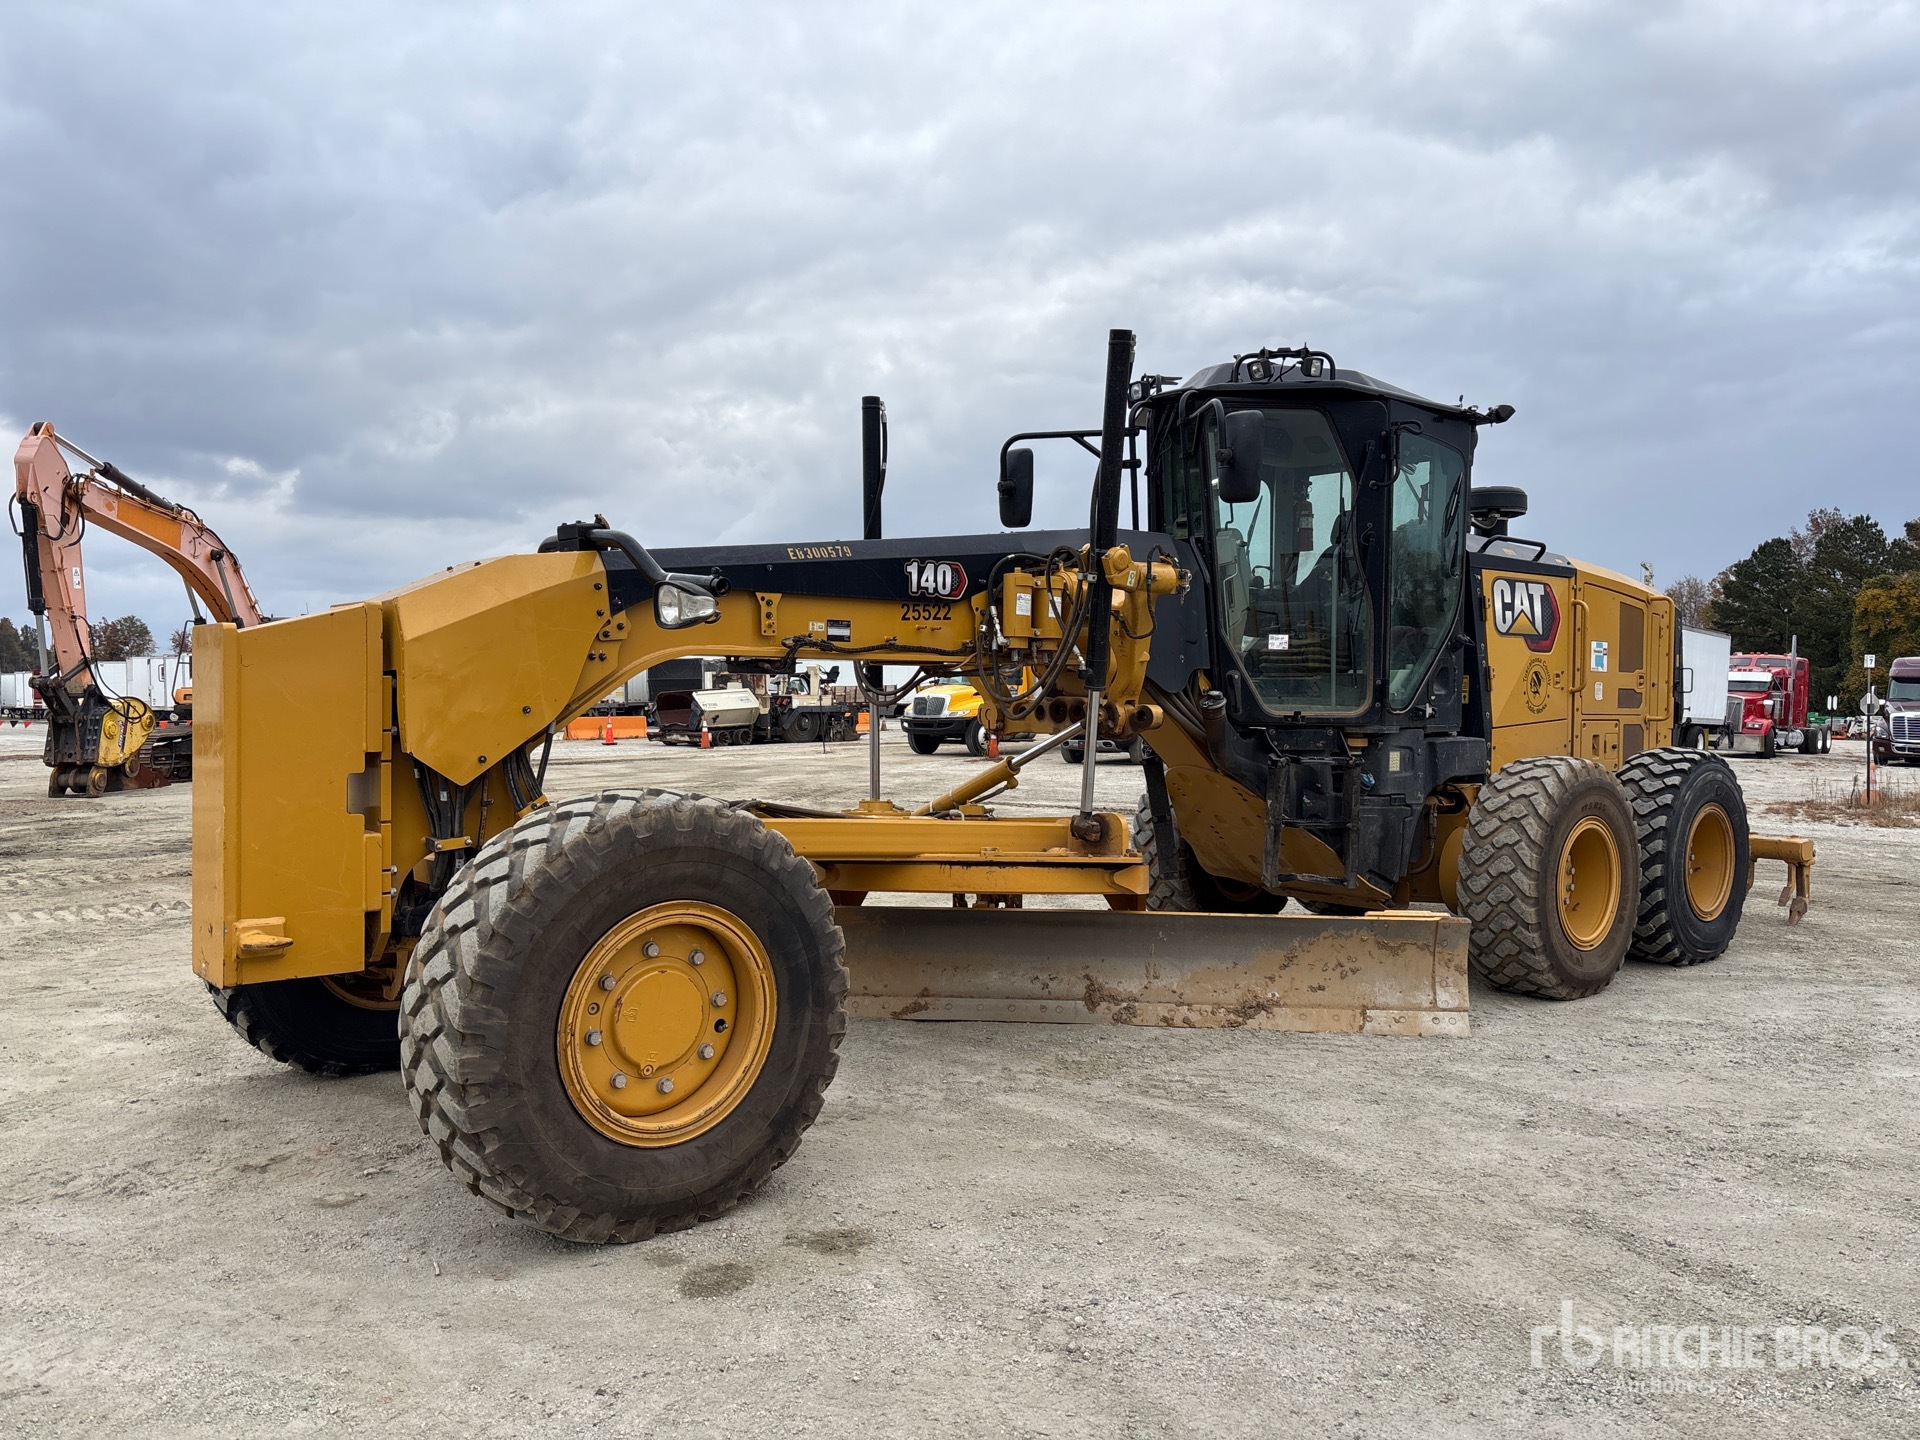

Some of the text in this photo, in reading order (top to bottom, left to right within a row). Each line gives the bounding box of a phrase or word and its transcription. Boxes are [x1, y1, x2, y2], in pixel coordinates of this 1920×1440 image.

[906, 562, 951, 595] 140
[901, 603, 952, 621] 25522
[1493, 579, 1545, 635] CAT
